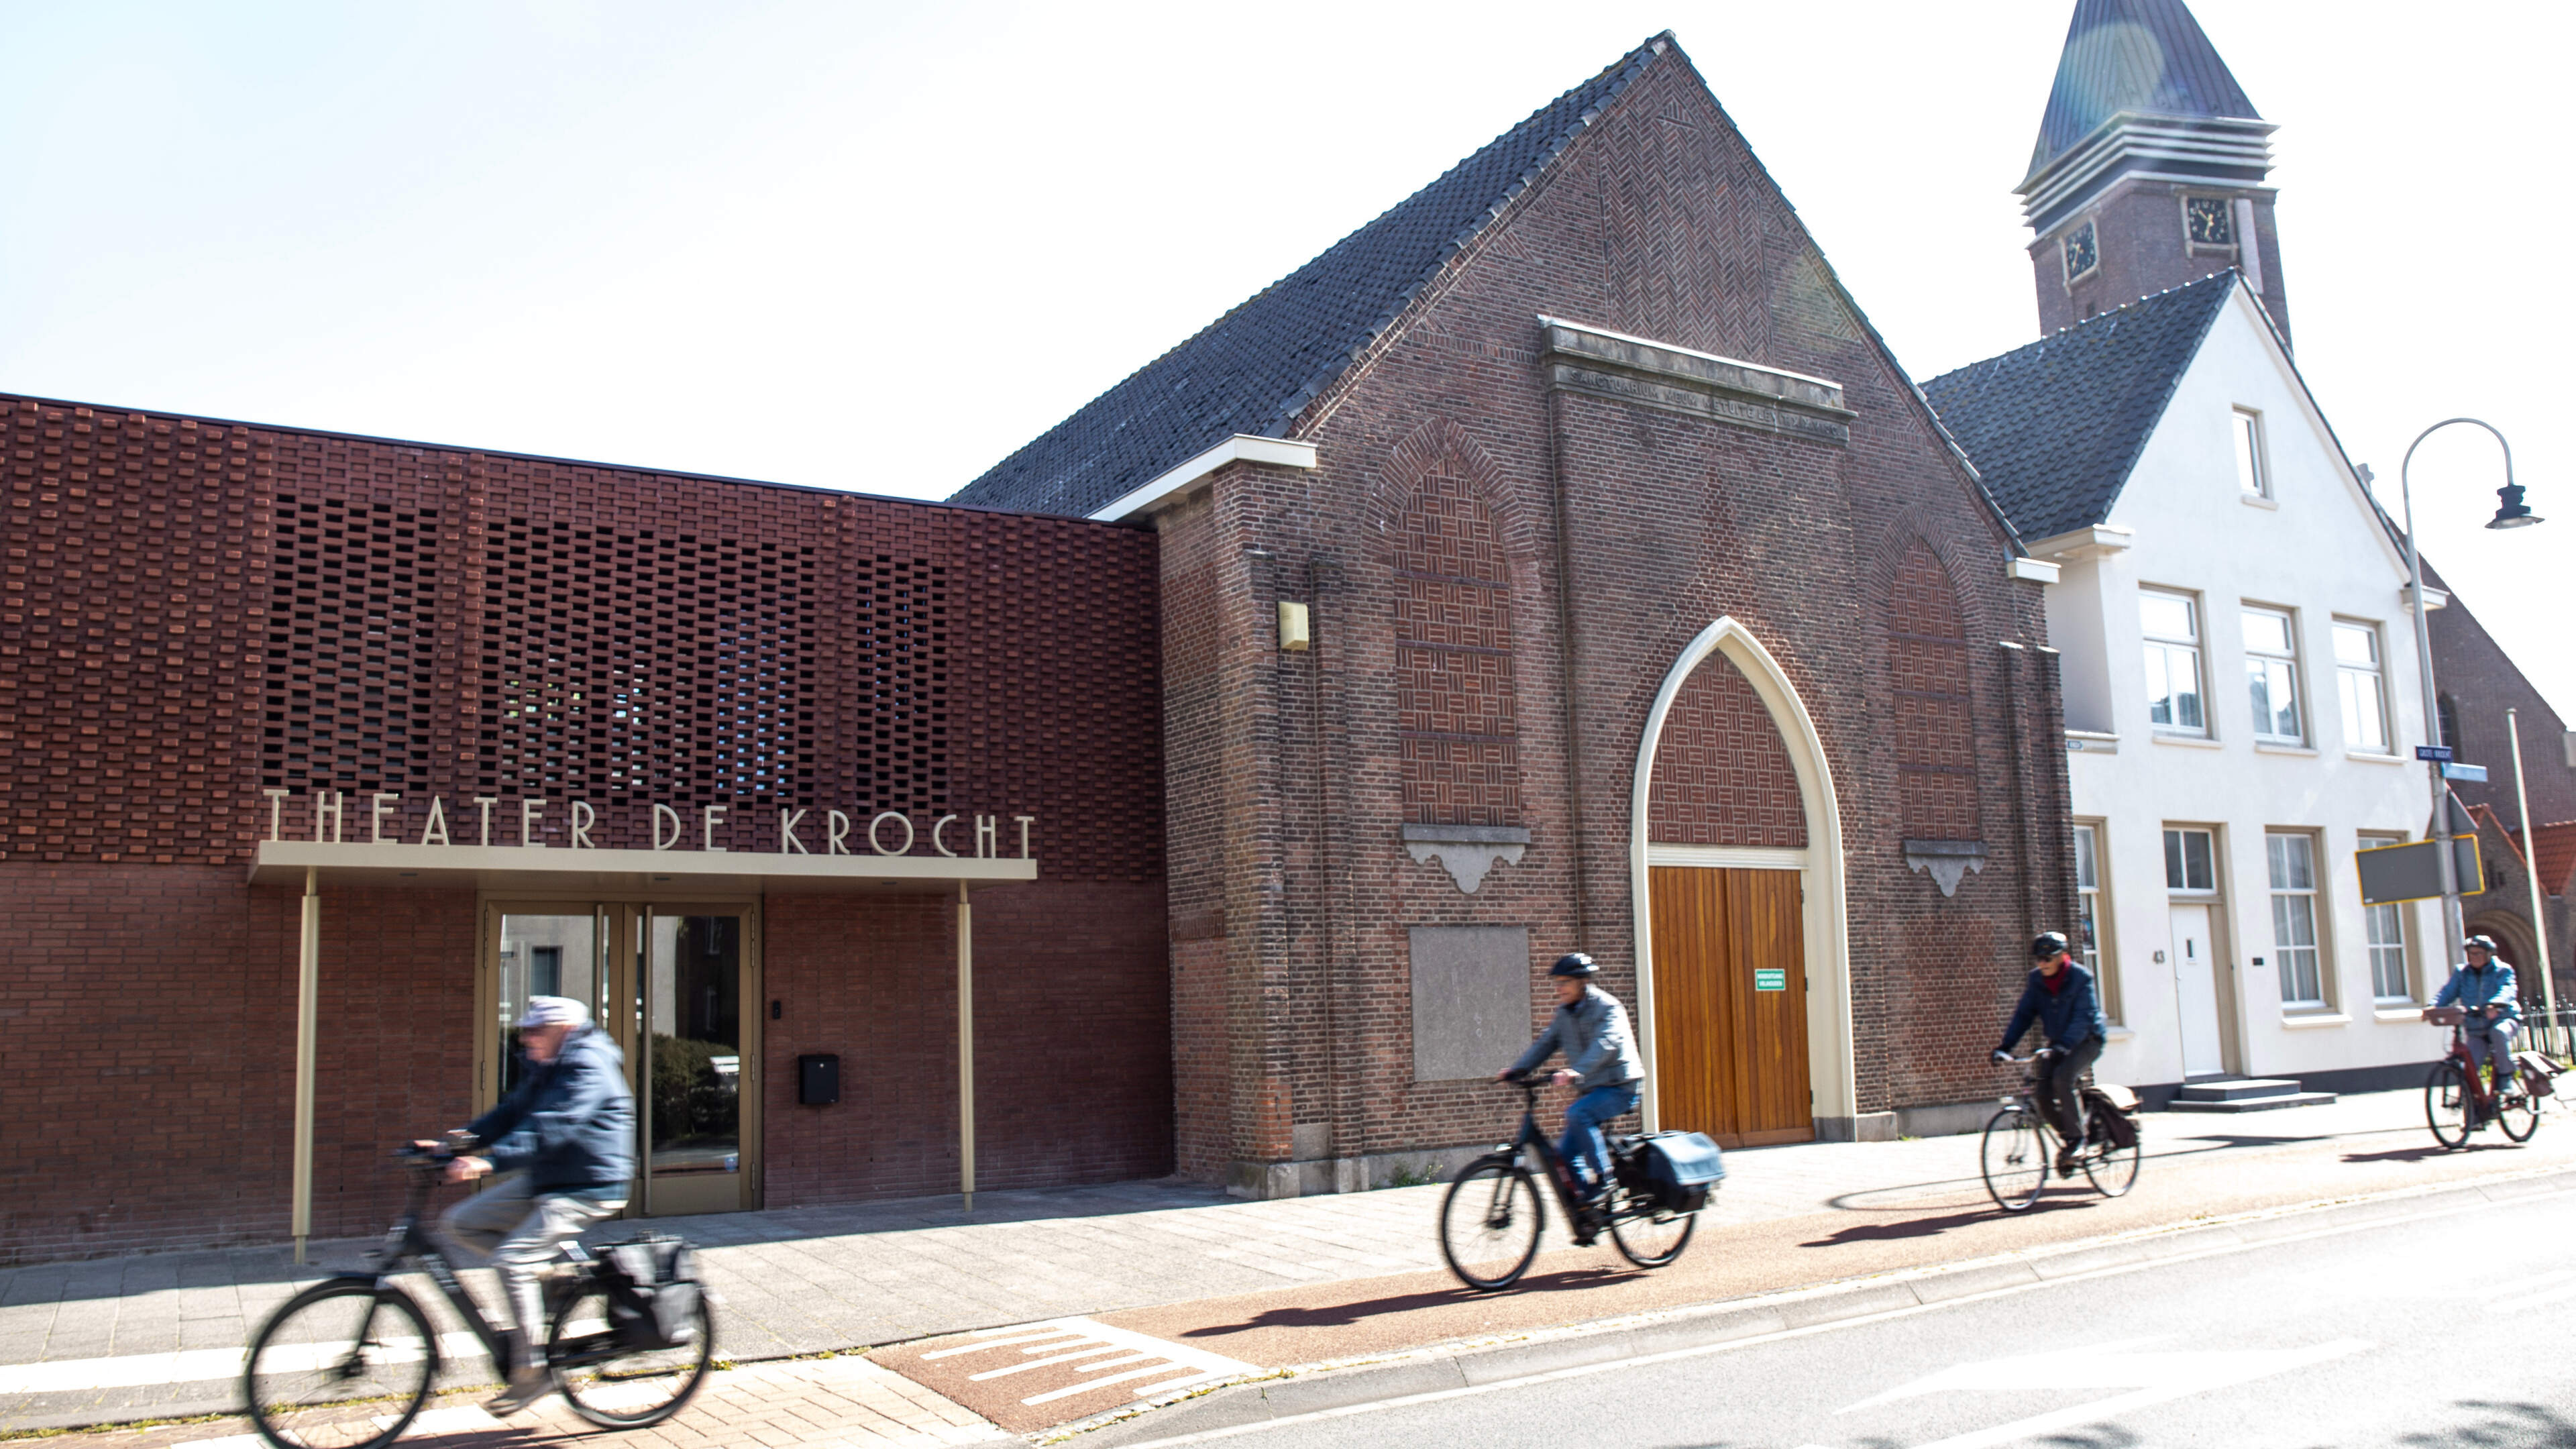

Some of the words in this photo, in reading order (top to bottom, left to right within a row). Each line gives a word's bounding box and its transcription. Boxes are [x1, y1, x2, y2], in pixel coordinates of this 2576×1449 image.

[1570, 370, 1659, 399] SANCTUARIUM
[1664, 390, 1698, 407] MEUM
[263, 788, 595, 849] THEATER
[653, 802, 728, 853] DE
[781, 808, 1035, 859] KROCHT
[2153, 949, 2165, 965] 43
